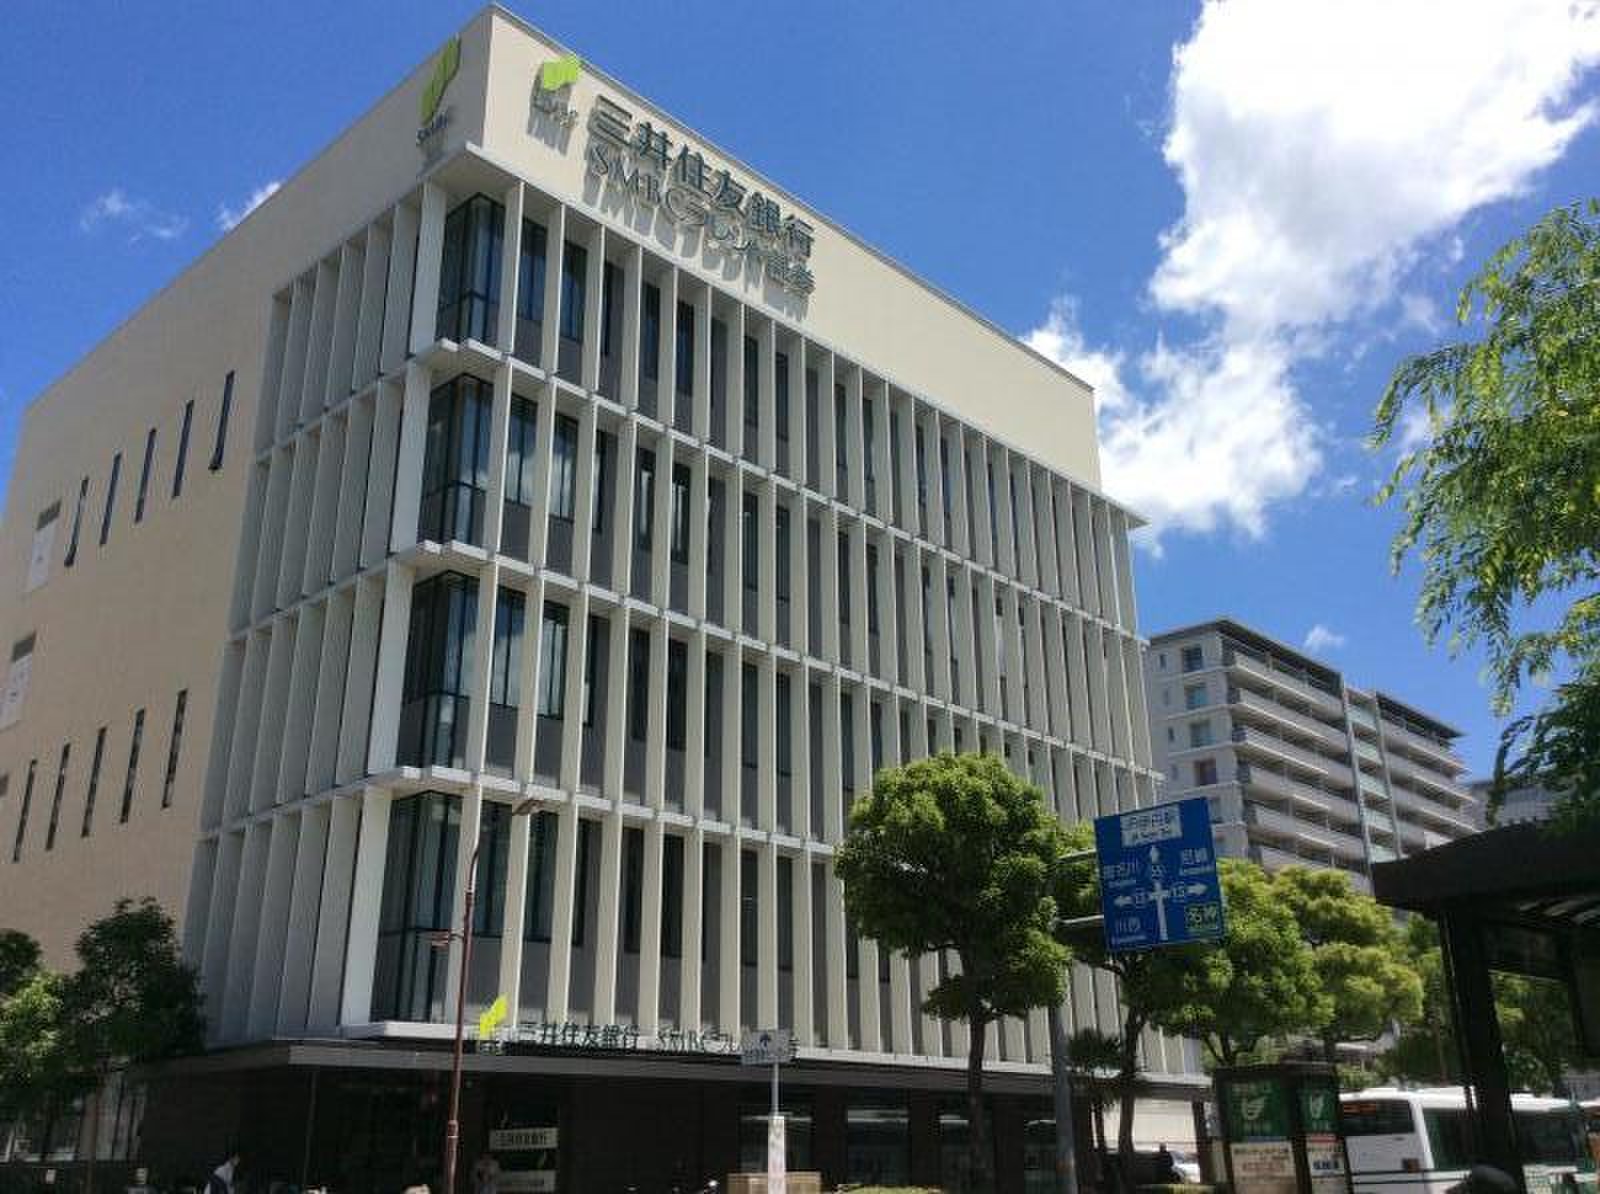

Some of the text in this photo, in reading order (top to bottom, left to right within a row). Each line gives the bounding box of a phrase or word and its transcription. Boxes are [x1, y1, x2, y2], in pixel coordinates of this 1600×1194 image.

[596, 94, 815, 258] 三井住友銀行
